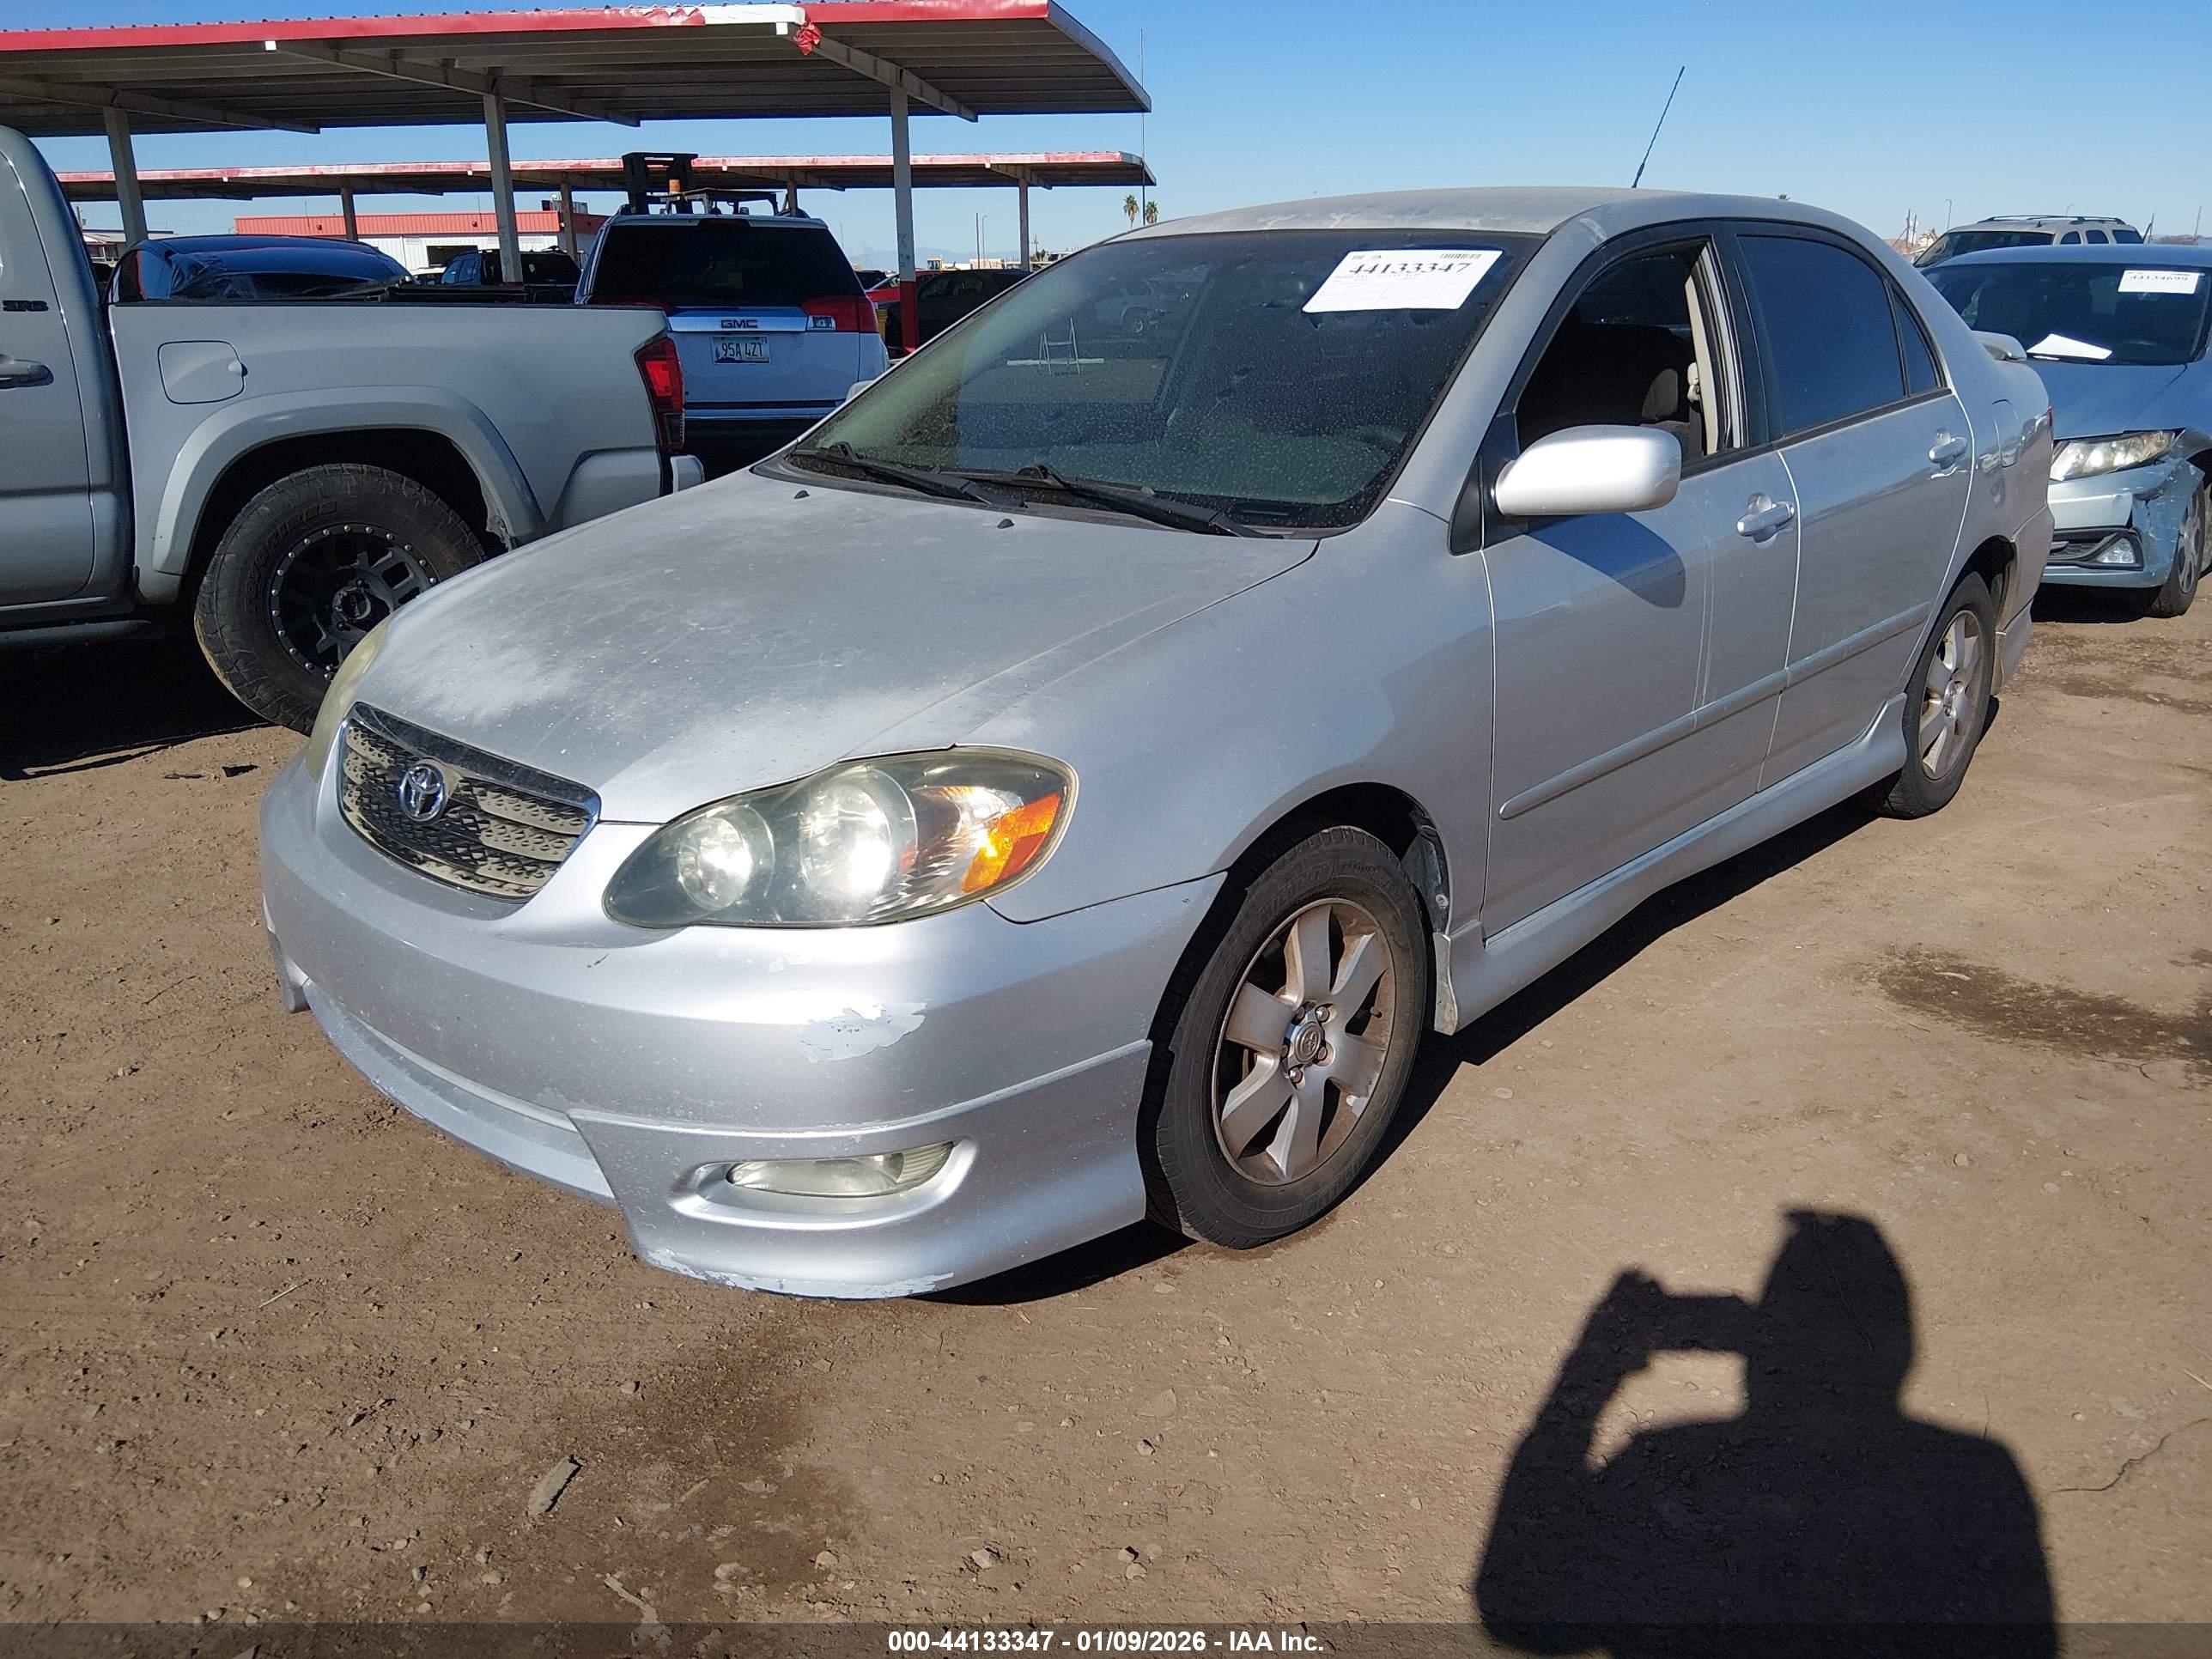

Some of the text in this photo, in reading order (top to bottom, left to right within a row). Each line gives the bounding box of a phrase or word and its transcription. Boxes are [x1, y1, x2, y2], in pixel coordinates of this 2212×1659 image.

[1349, 262, 1471, 275] 44133347
[720, 319, 757, 329] GMC
[721, 343, 742, 357] 95A
